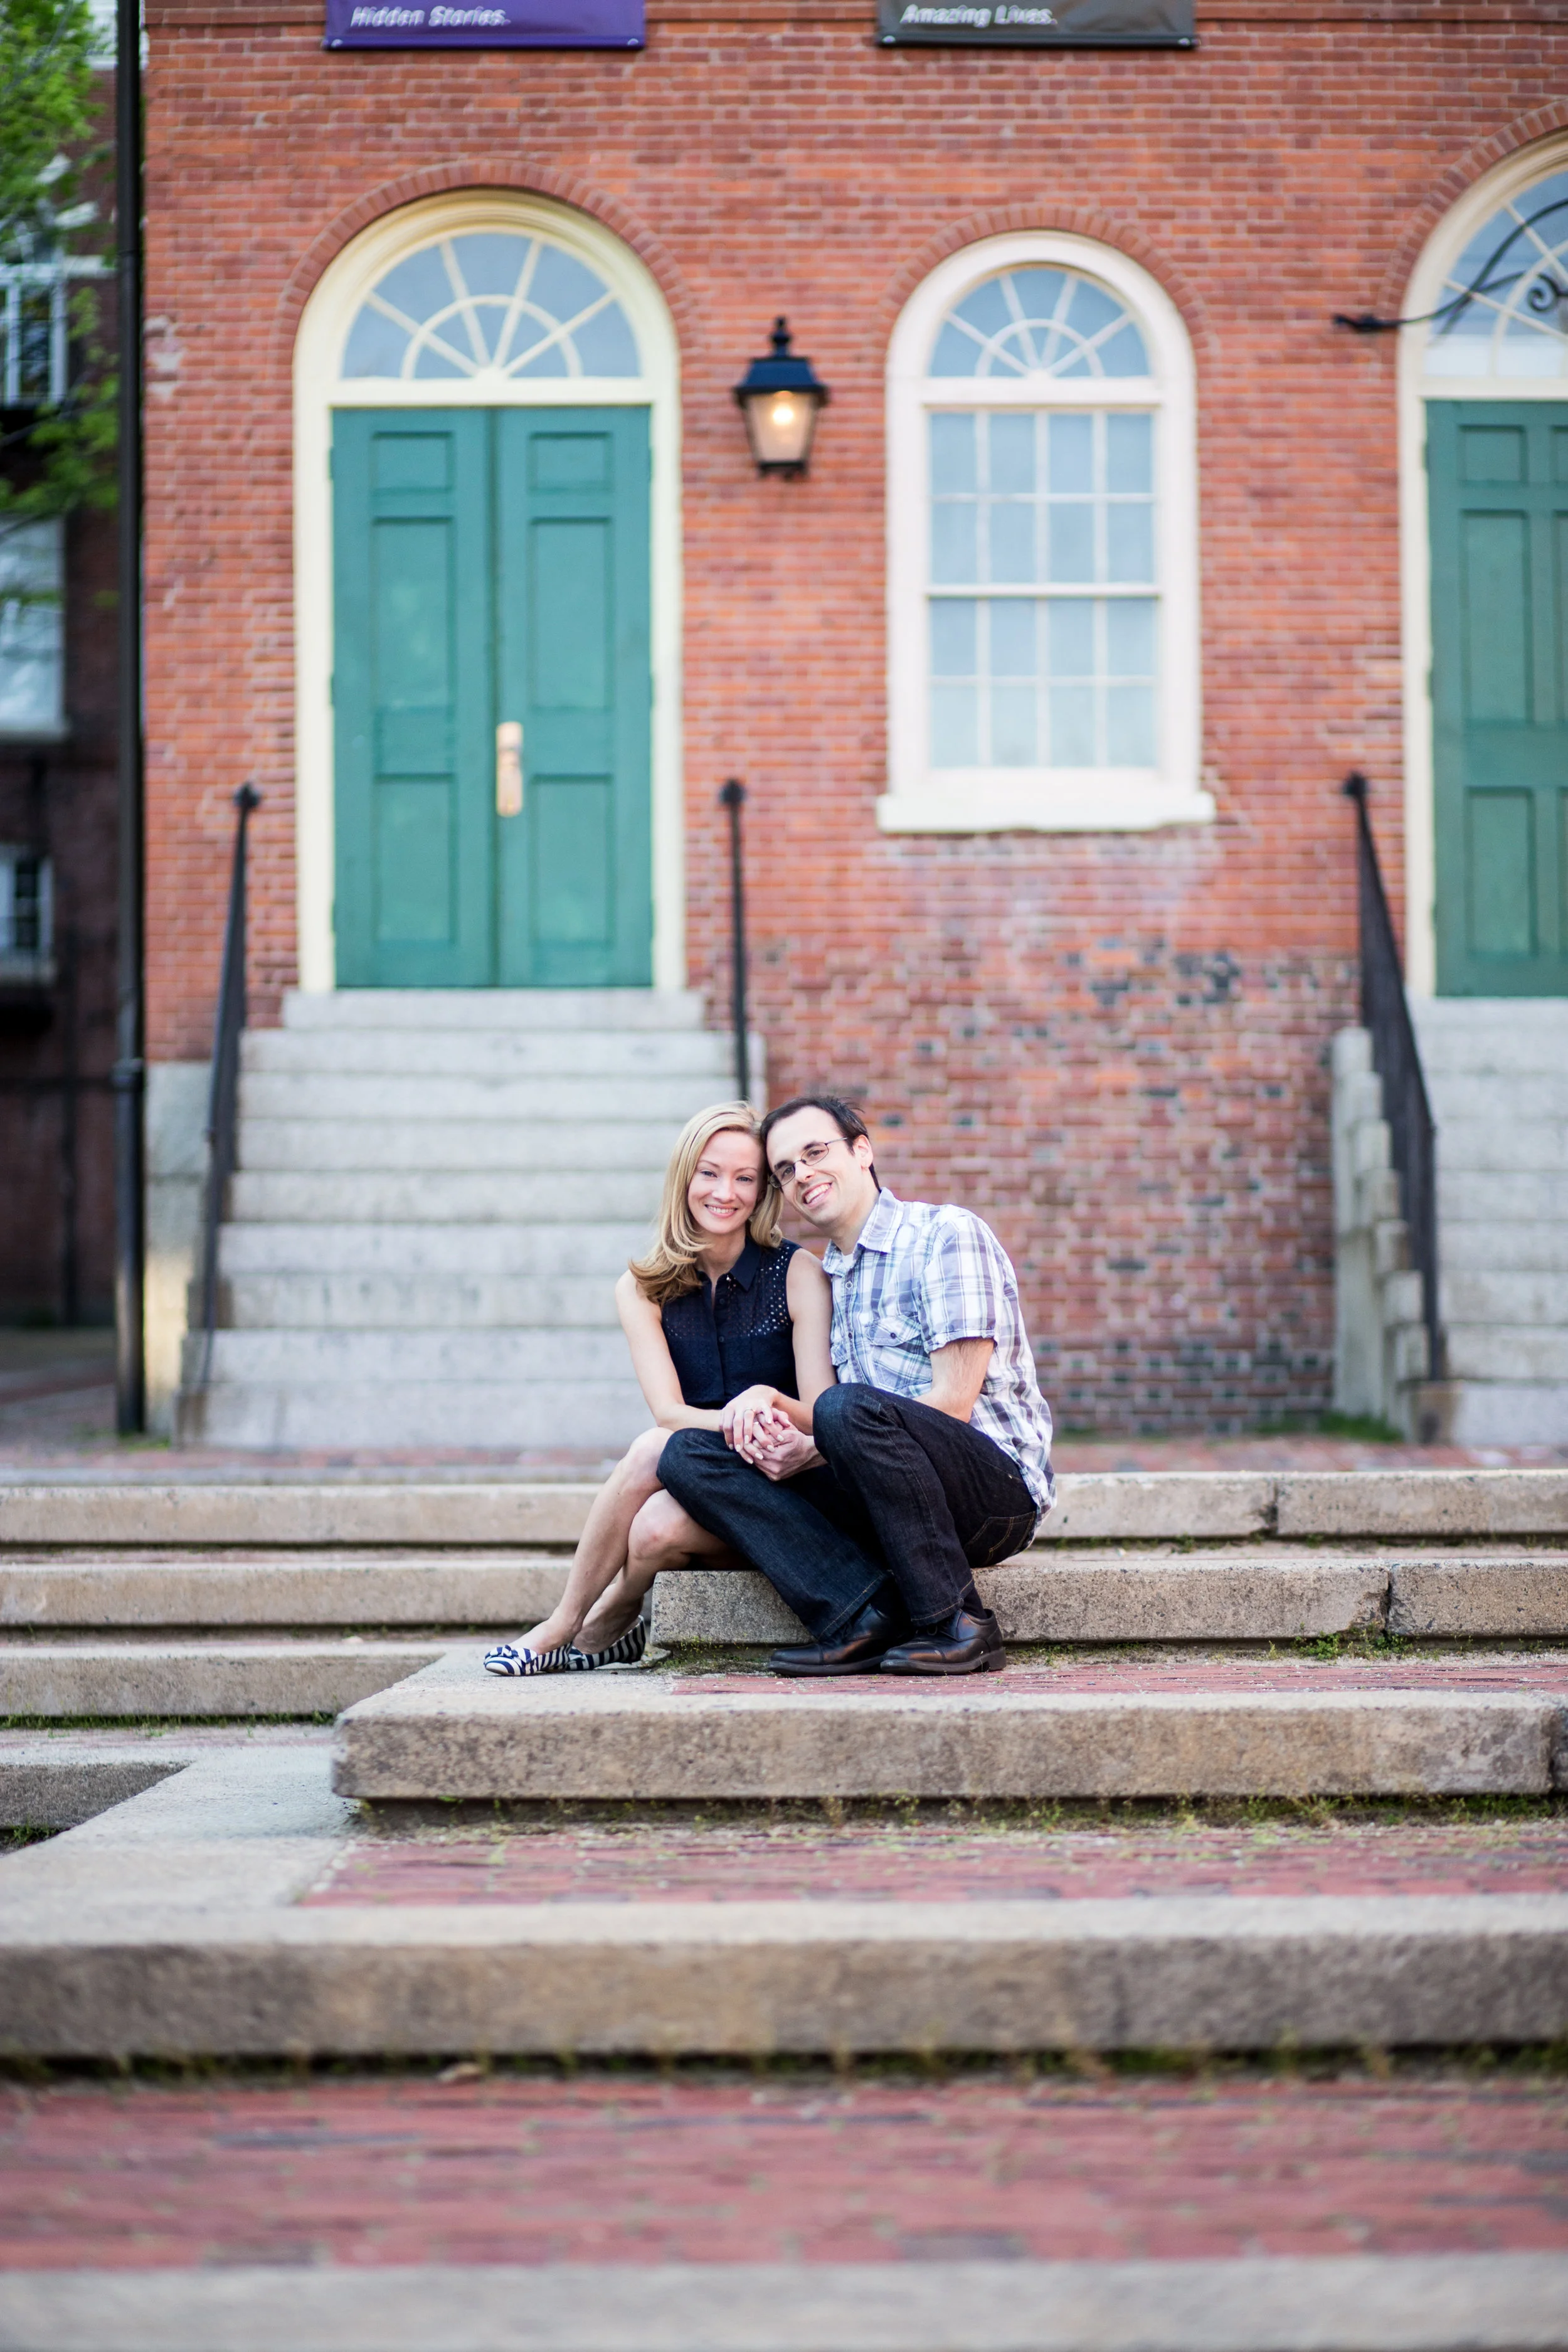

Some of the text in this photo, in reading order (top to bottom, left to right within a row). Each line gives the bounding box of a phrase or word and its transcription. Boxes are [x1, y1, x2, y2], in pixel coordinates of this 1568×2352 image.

[351, 6, 511, 27] Hidden Stories.
[900, 4, 992, 28] Amazing
